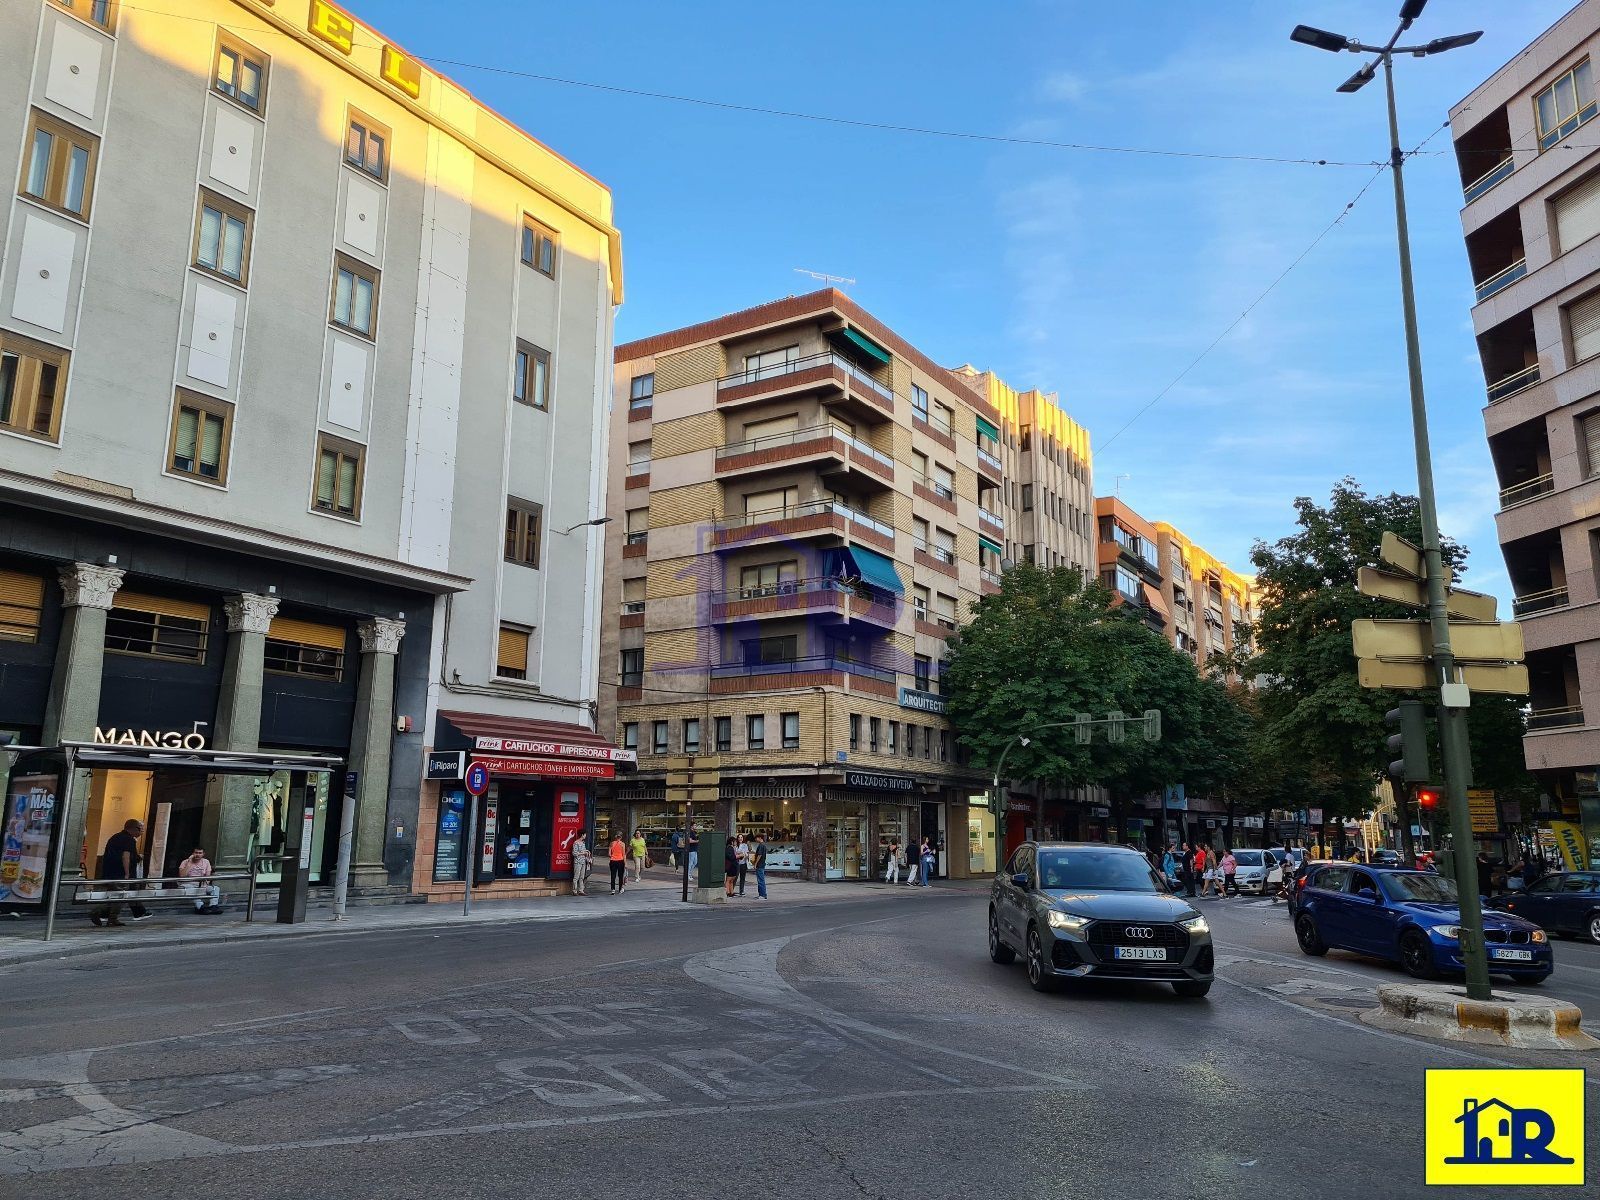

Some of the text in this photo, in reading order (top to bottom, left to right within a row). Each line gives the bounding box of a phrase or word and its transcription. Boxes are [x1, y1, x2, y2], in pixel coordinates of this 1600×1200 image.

[94, 726, 205, 750] MANGO
[505, 741, 555, 753] CARTUCHOS
[560, 746, 608, 758] IMPRESORAS
[569, 766, 604, 775] IMPRESORAS
[850, 774, 914, 790] CALZADOS RIVERA
[441, 796, 462, 804] DIGI
[1120, 948, 1164, 959] 2513 LXS
